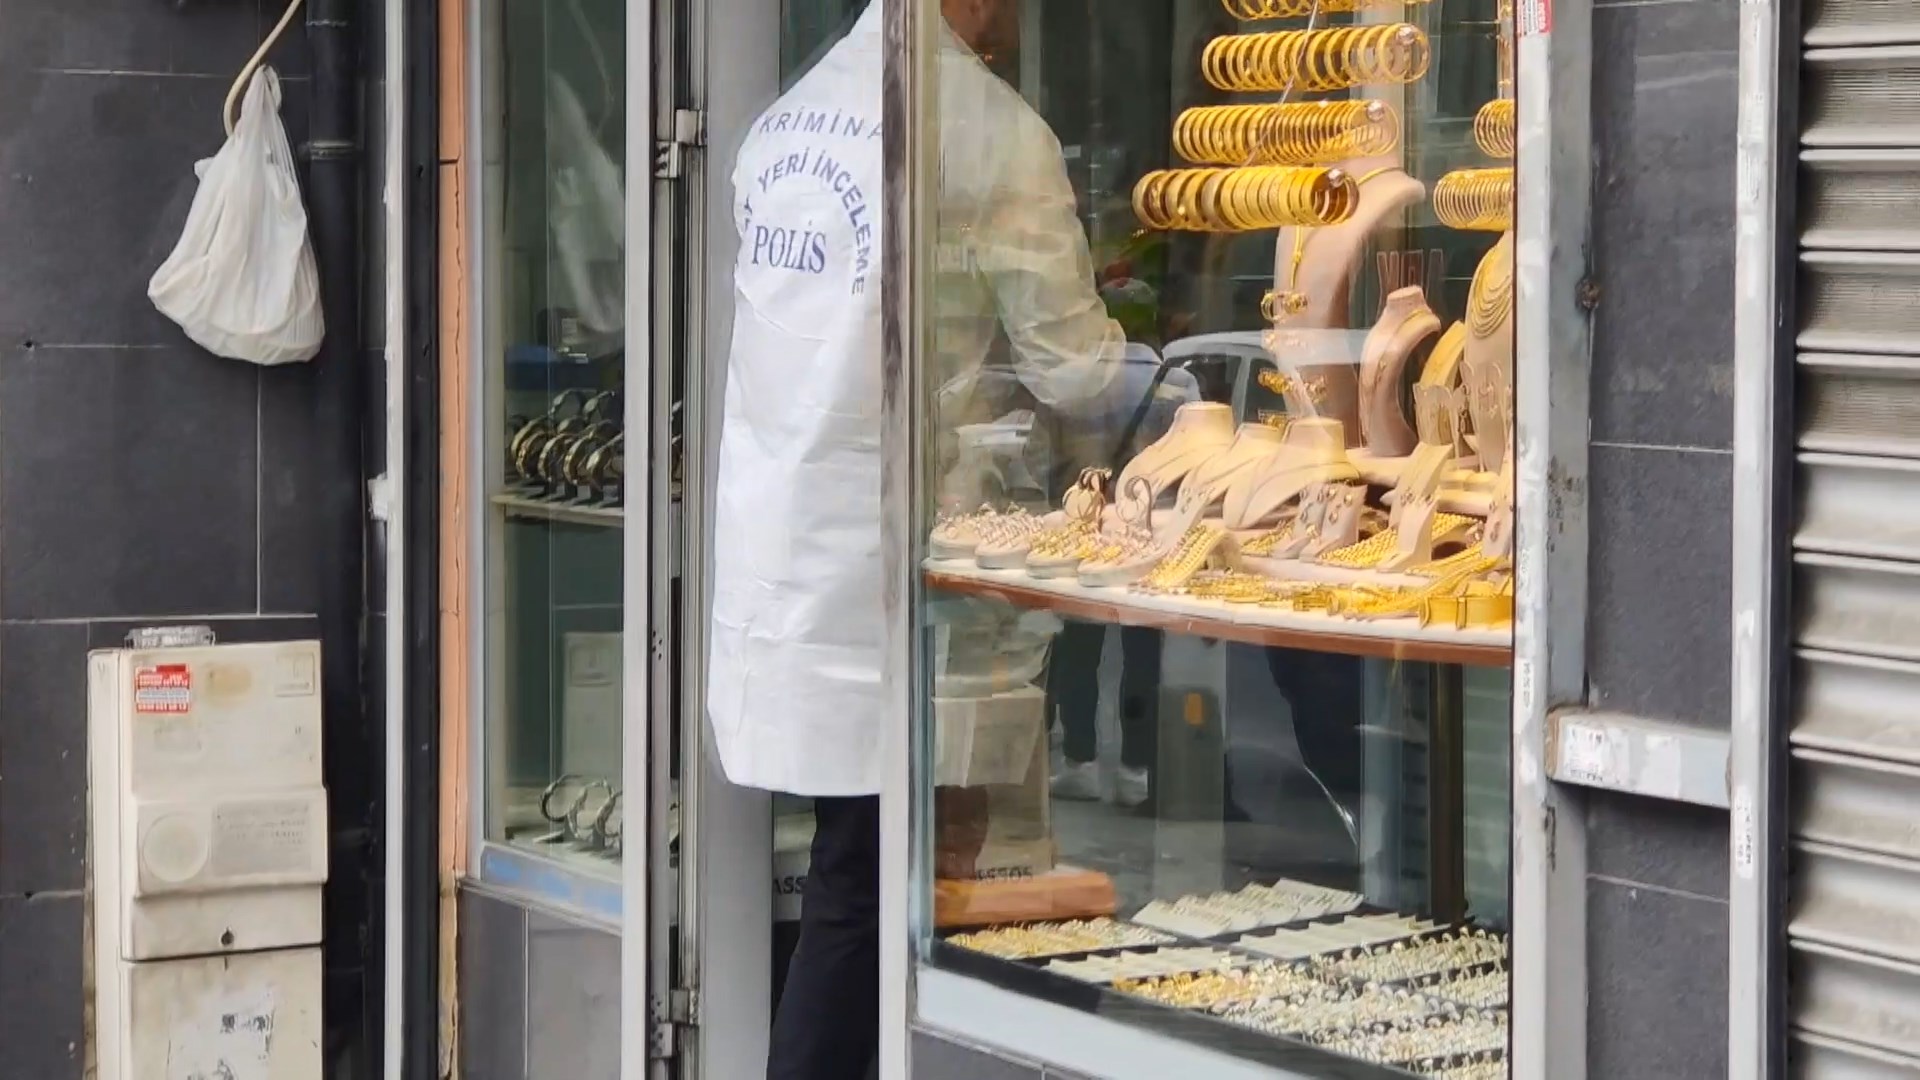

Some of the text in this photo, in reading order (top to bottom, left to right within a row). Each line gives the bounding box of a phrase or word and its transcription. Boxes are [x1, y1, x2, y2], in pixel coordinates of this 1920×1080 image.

[752, 221, 827, 274] POLİS
[758, 147, 809, 194] YERİ
[812, 149, 871, 295] İNCELEME
